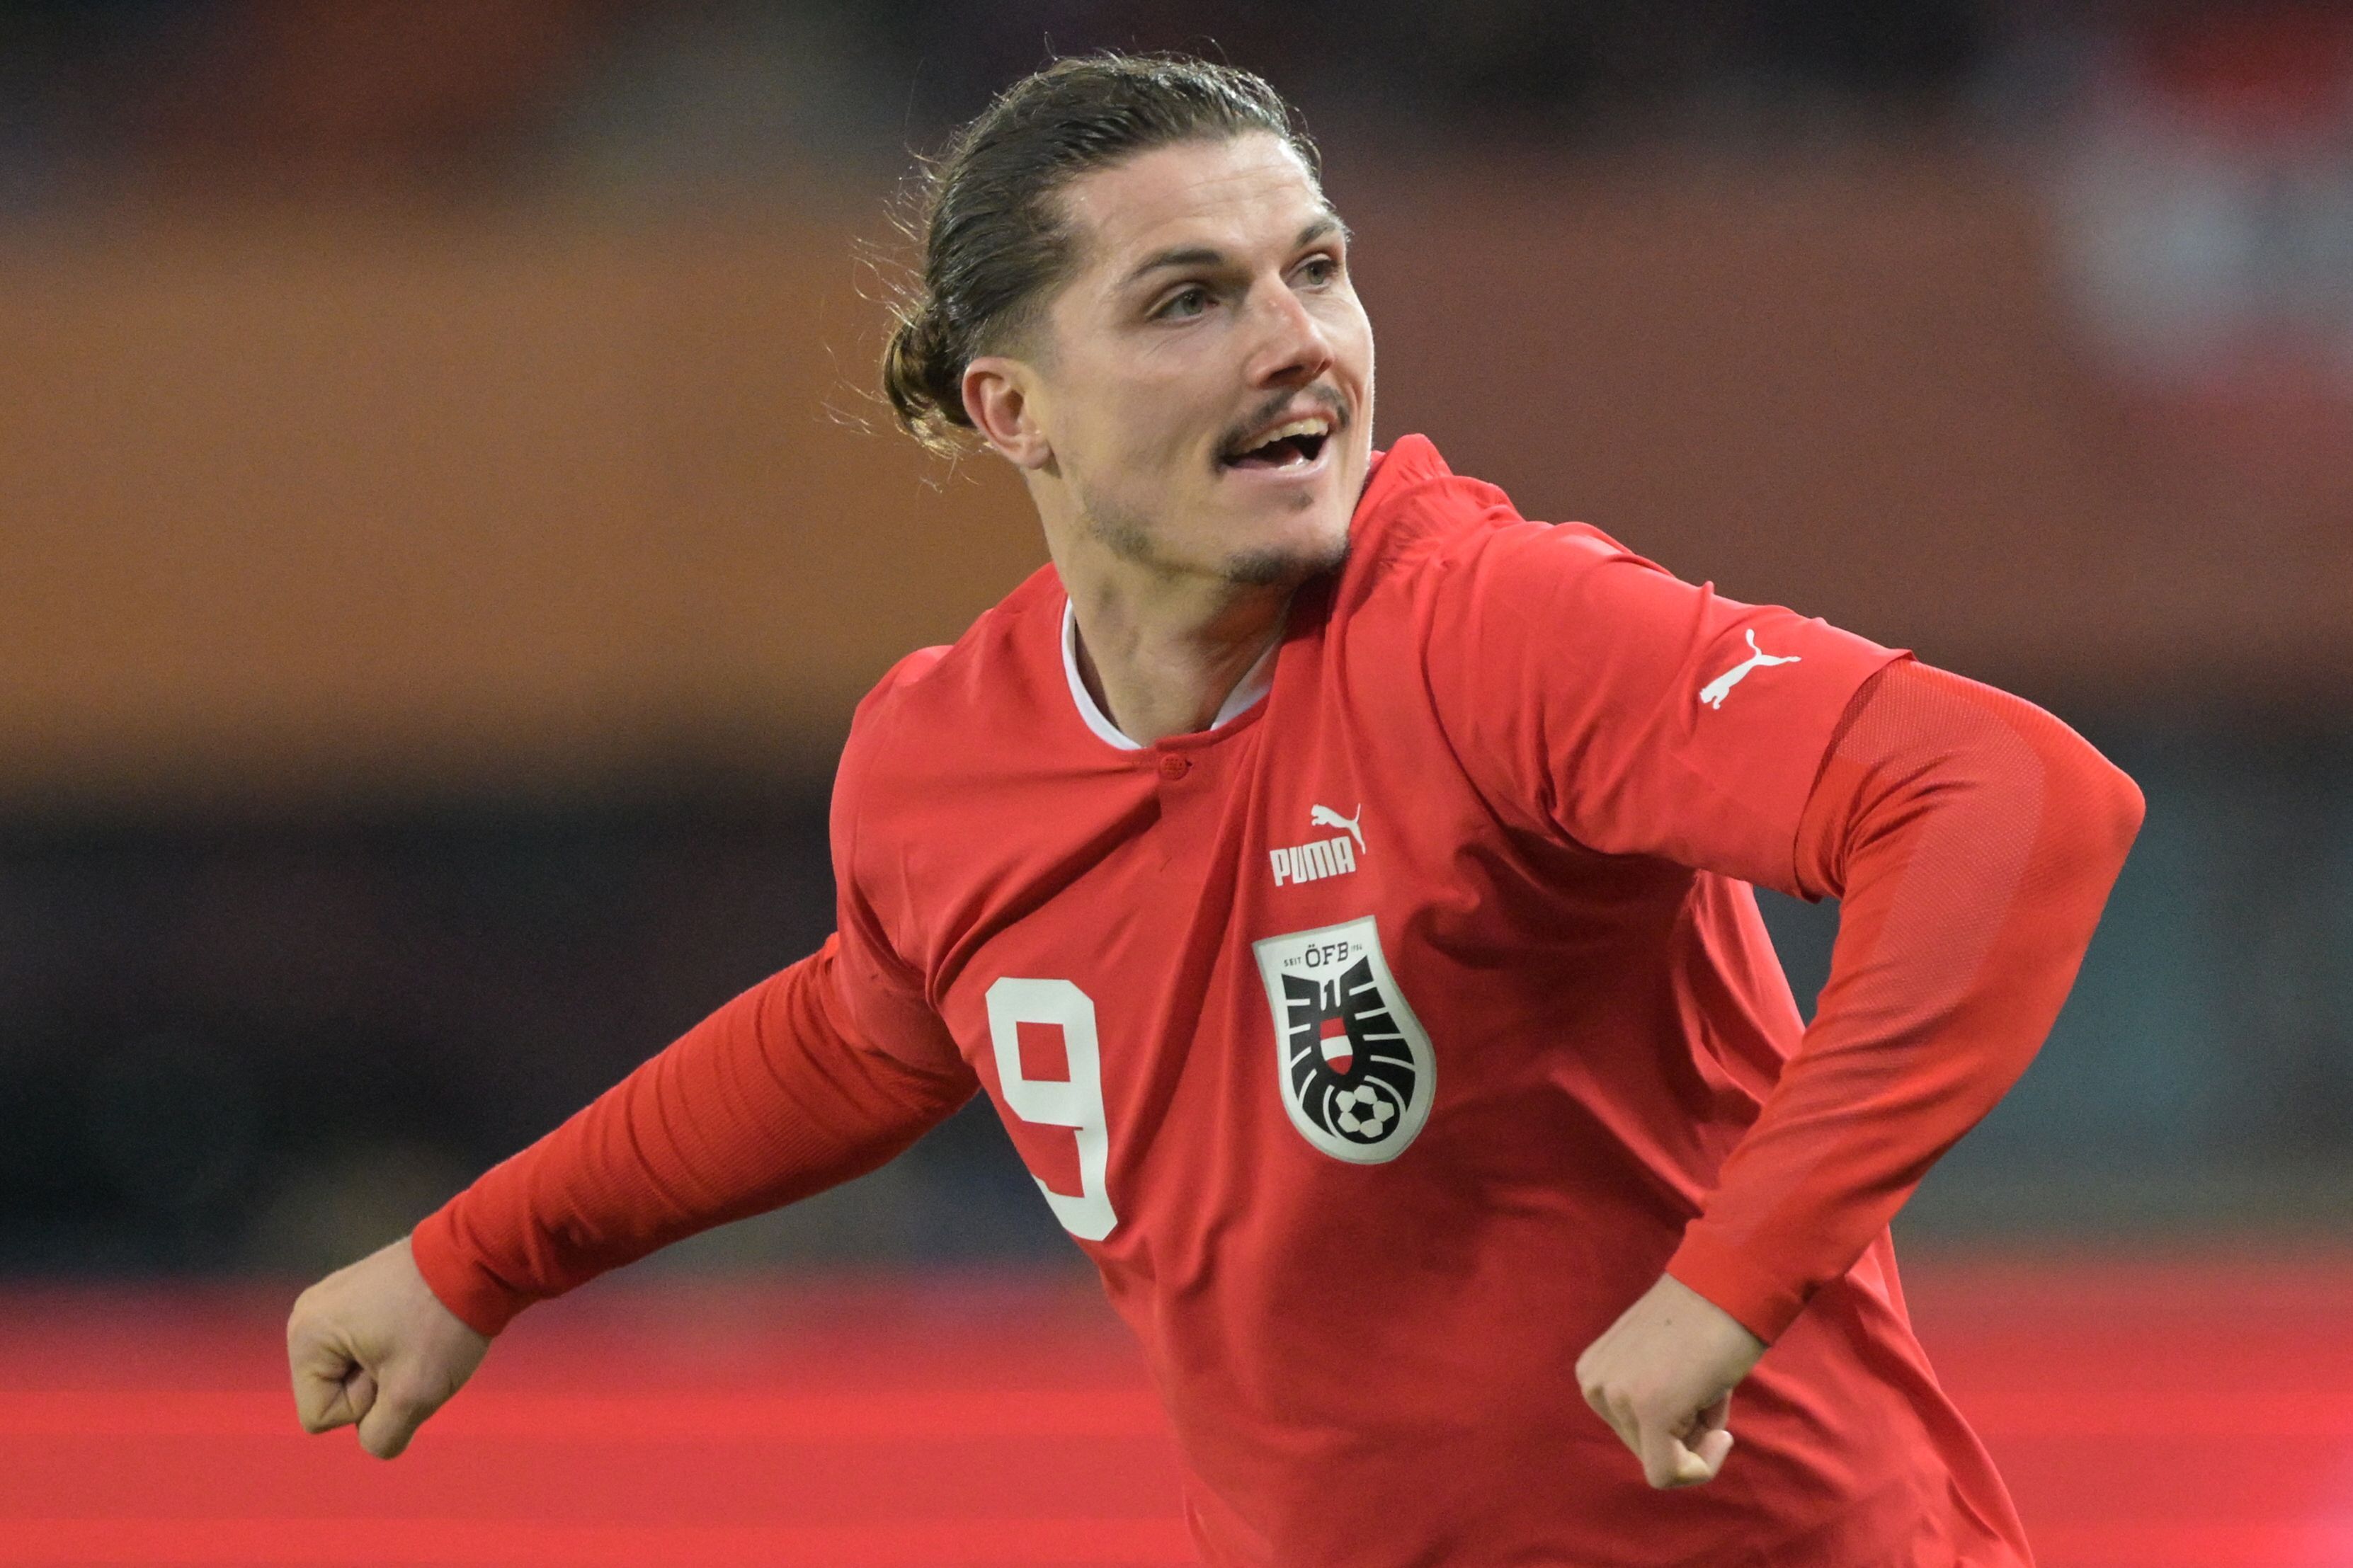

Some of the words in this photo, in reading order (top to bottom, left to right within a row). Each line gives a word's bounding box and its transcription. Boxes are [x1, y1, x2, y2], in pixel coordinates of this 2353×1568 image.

[1270, 836, 1356, 886] PUMA
[1284, 956, 1301, 967] SEIT
[1305, 942, 1349, 968] ÖFB
[985, 976, 1118, 1241] 9
